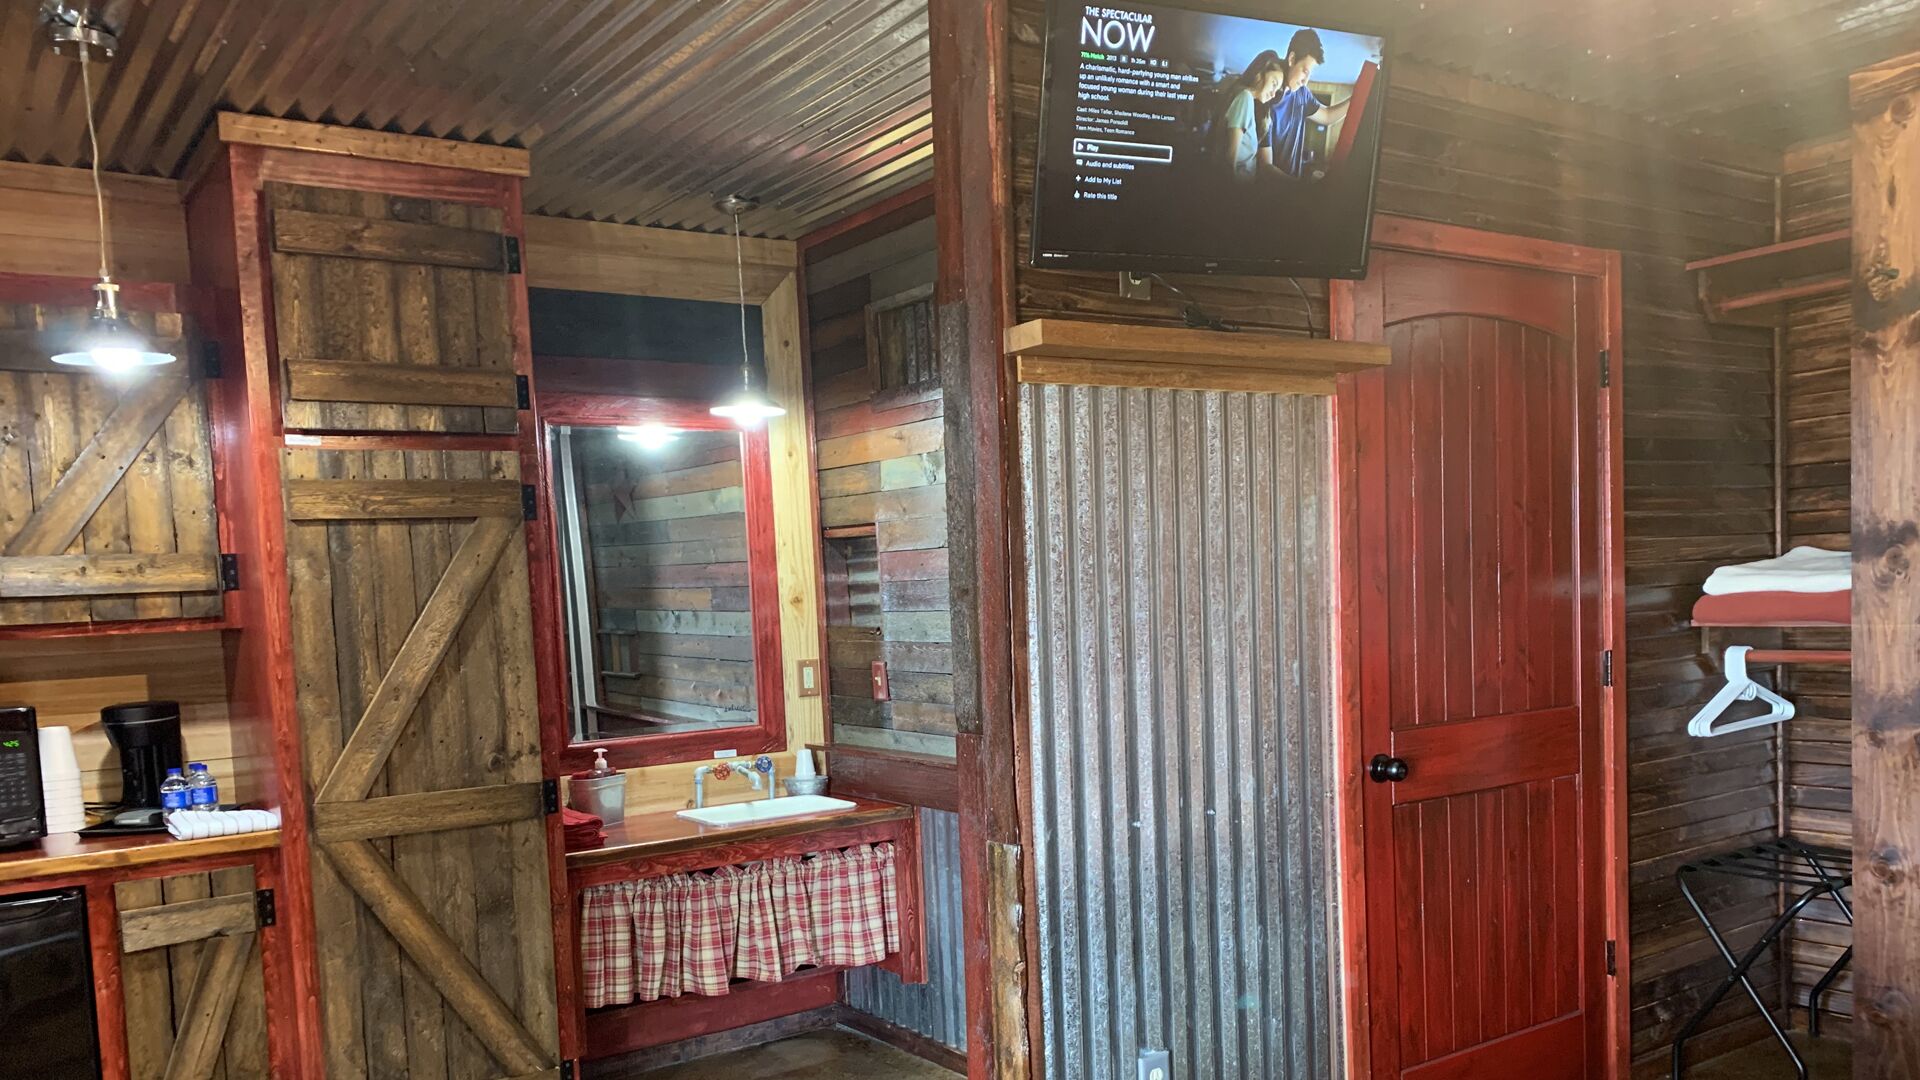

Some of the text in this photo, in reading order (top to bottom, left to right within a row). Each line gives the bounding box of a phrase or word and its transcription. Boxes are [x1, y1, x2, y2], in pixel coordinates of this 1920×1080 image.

[1085, 6, 1153, 24] THE SPECTACULAR
[1081, 16, 1156, 53] NOW
[1085, 63, 1117, 74] charismatic,
[1117, 67, 1154, 79] hard-partying
[1153, 72, 1170, 81] young
[1094, 75, 1116, 83] unlikely
[1079, 82, 1101, 90] focused
[1137, 89, 1154, 98] during
[1078, 91, 1110, 101] high school.
[1115, 128, 1136, 136] Romance
[1086, 143, 1099, 153] Play
[1086, 160, 1102, 168] Audio
[1112, 162, 1135, 170] subtitles
[1102, 177, 1112, 185] My
[1083, 191, 1097, 199] Rate
